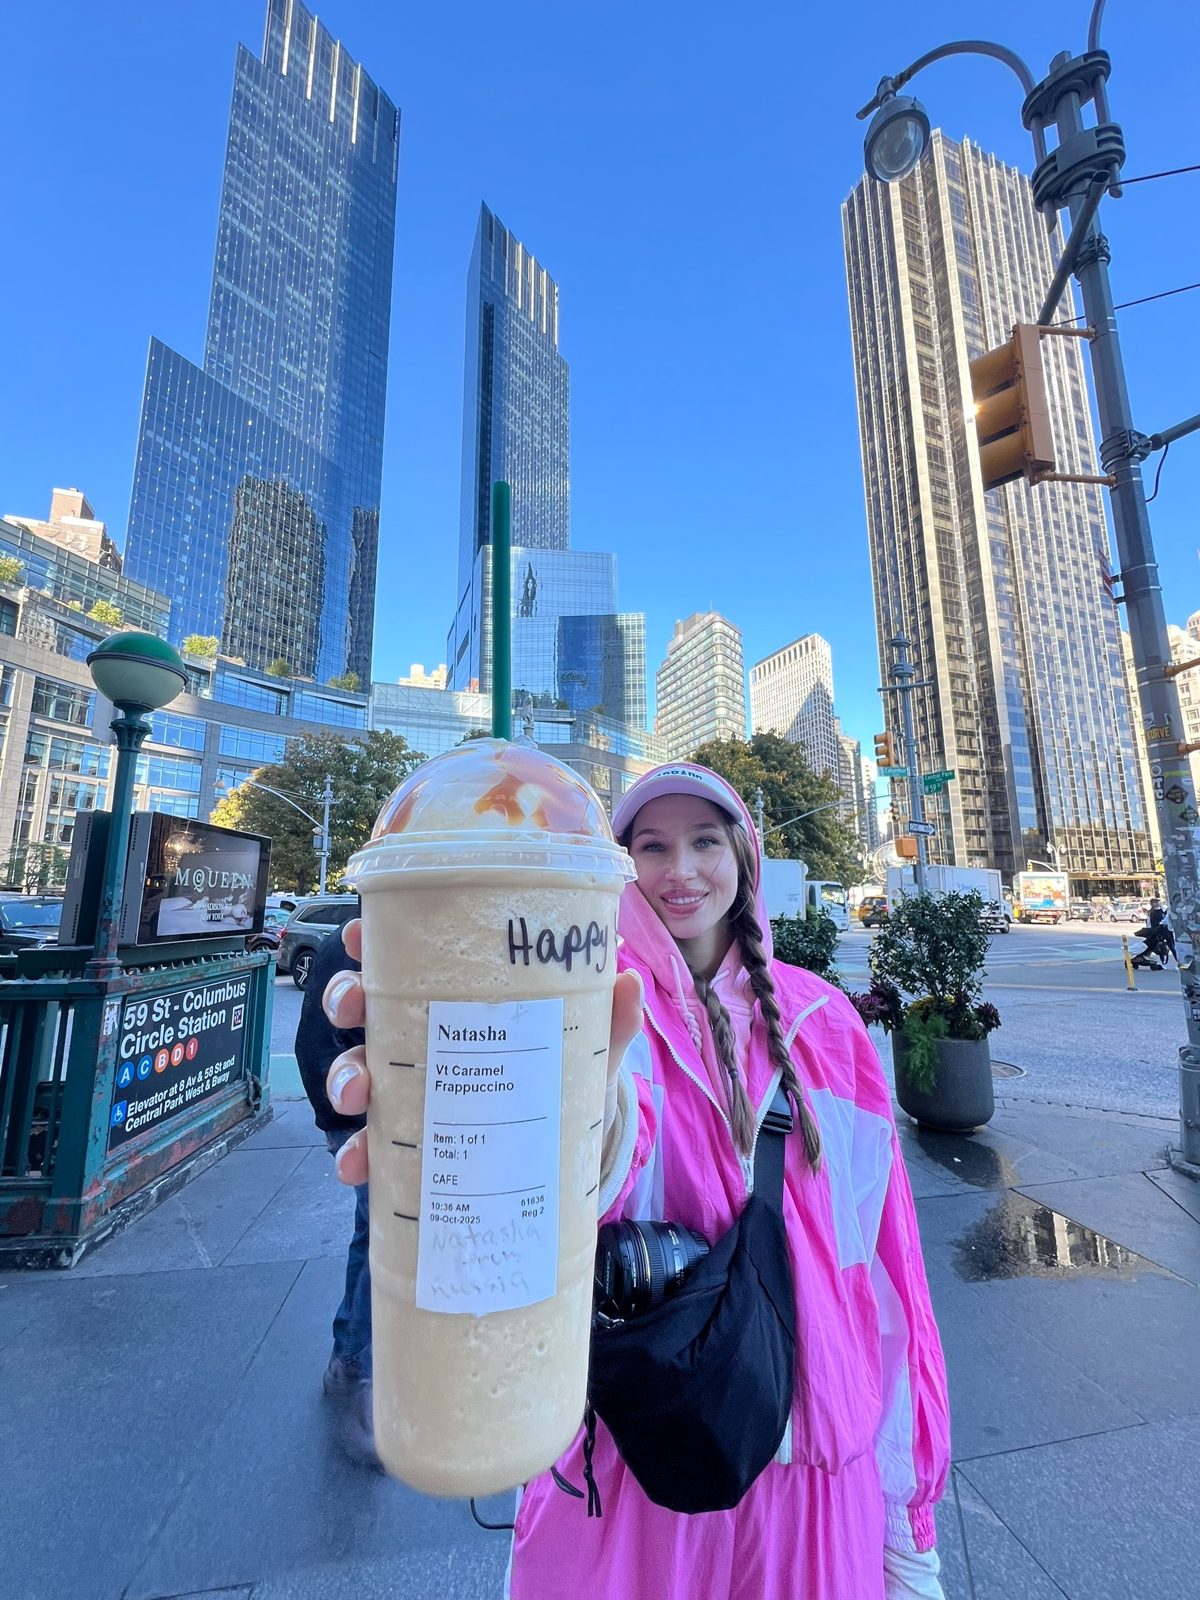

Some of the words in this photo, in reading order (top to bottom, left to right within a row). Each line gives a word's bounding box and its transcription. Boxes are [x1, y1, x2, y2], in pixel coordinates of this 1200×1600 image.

[929, 784, 936, 792] 59
[508, 917, 608, 973] Happy
[123, 1003, 148, 1030] 59
[151, 998, 171, 1022] St
[182, 981, 246, 1013] Columbus
[120, 1023, 174, 1059] Circle
[177, 1008, 226, 1040] Station
[438, 1024, 507, 1041] Natasha
[120, 1067, 130, 1083] A
[139, 1060, 150, 1075] C
[157, 1053, 166, 1068] B
[173, 1048, 182, 1060] D
[436, 1064, 449, 1076] Vt
[452, 1065, 504, 1077] Caramel
[127, 1089, 168, 1118] Elevator
[169, 1083, 178, 1095] at
[179, 1080, 185, 1091] 8
[185, 1074, 197, 1088] Av
[197, 1070, 203, 1082] &
[203, 1066, 214, 1079] 58
[214, 1062, 223, 1075] St
[222, 1055, 235, 1069] and
[435, 1080, 514, 1095] Frappuccino
[125, 1106, 162, 1132] Central
[163, 1096, 184, 1113] Park
[185, 1086, 204, 1102] West
[205, 1078, 211, 1090] &
[212, 1071, 230, 1088] Bway
[433, 1133, 456, 1145] Item:
[460, 1134, 464, 1144] 1
[467, 1134, 477, 1145] of
[481, 1134, 485, 1144] 1
[433, 1148, 459, 1159] Total:
[463, 1150, 468, 1159] 1
[432, 1173, 458, 1185] CAFE
[431, 1202, 453, 1212] 10:36
[455, 1203, 470, 1212] AM
[521, 1208, 538, 1219] Reg
[539, 1207, 544, 1215] 2
[430, 1214, 481, 1224] 09-Oct-2025
